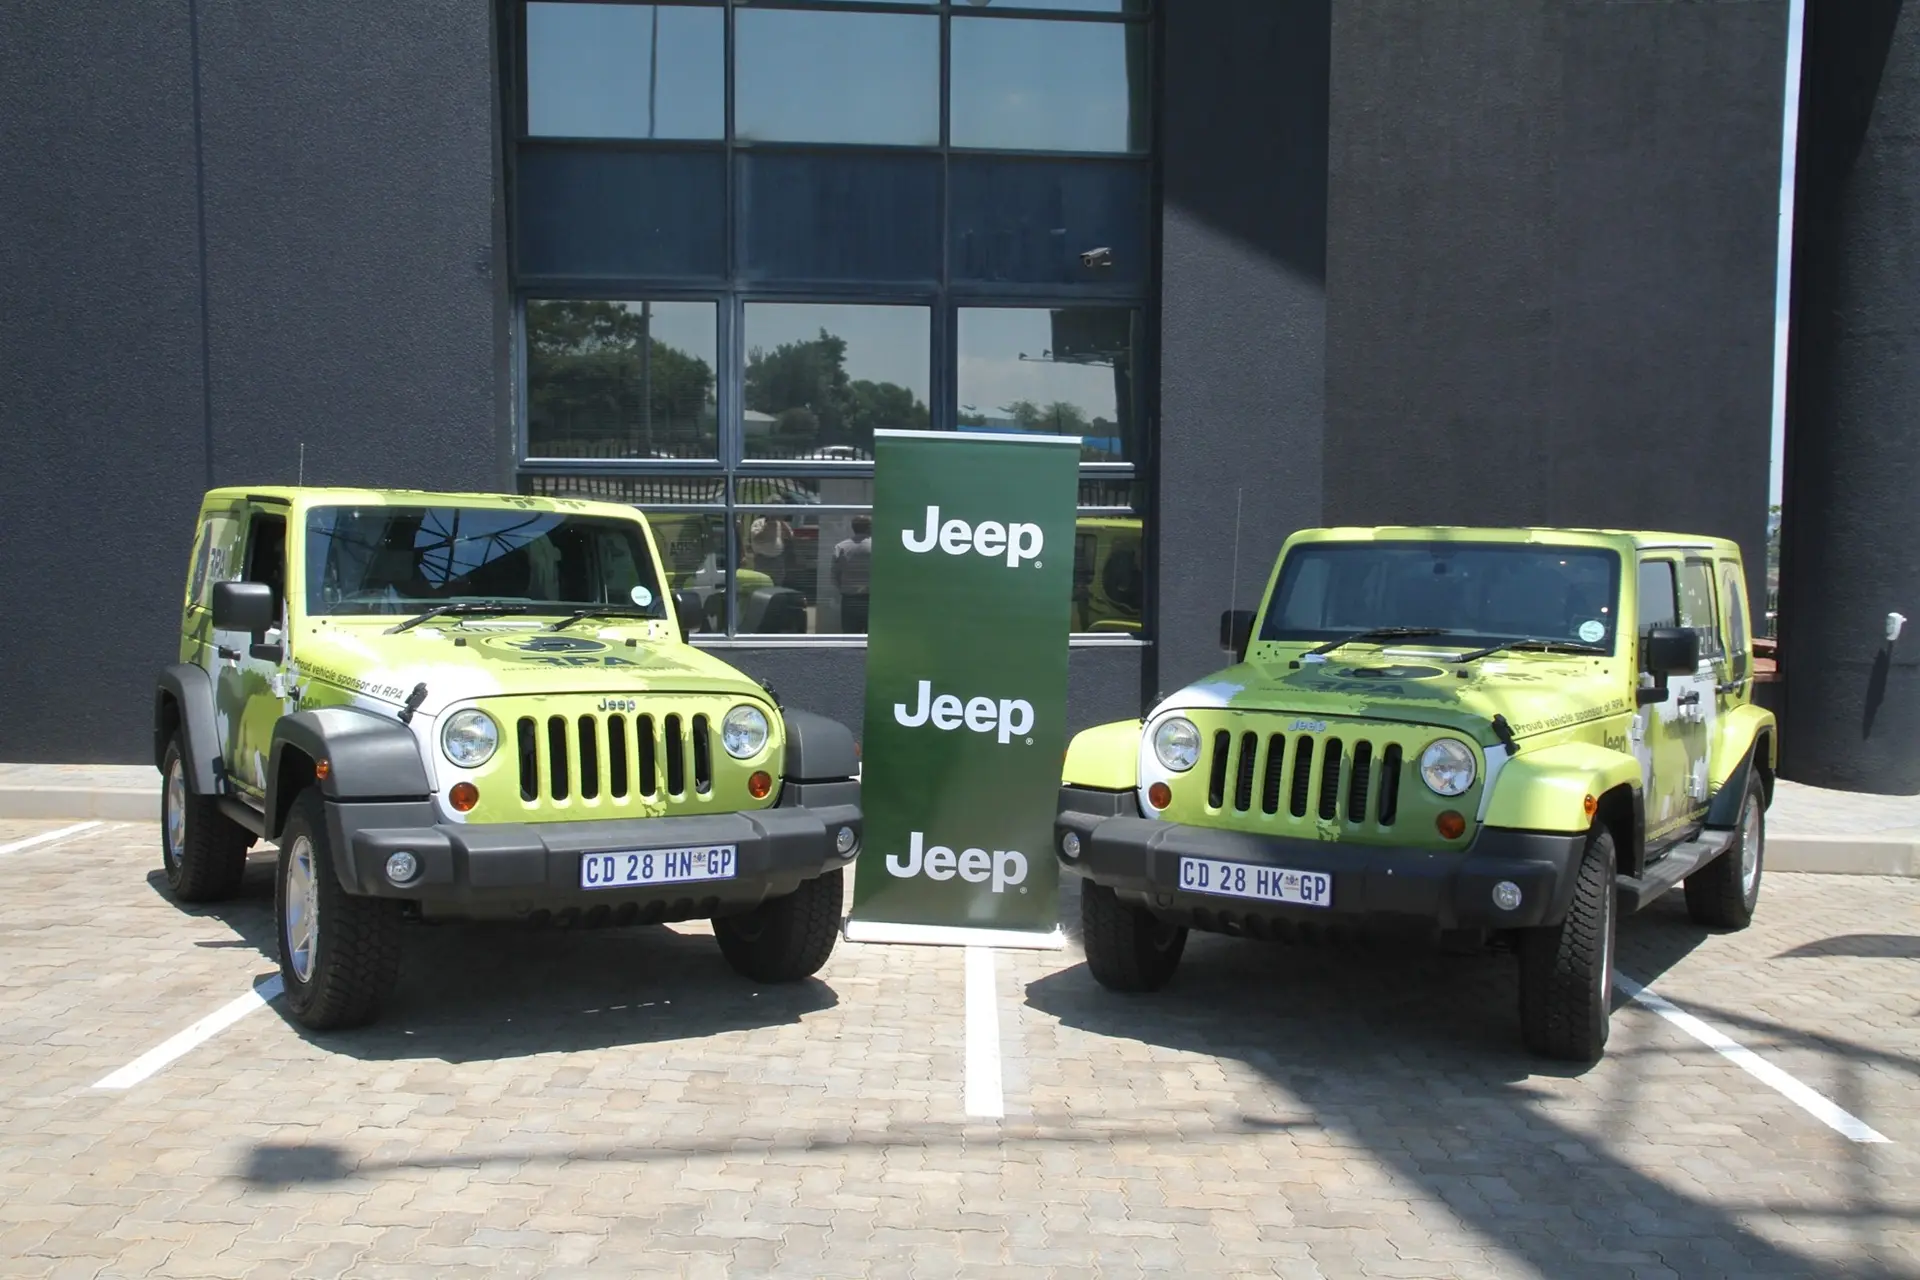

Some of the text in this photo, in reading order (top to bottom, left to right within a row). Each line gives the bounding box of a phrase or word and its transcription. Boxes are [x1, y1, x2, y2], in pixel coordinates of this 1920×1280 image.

[902, 506, 1043, 567] Jeep
[294, 657, 404, 700] Proud vehicle sponsor of RPA
[598, 698, 636, 713] Jeep
[894, 680, 1034, 743] Jeep
[1514, 699, 1624, 734] Proud vehicle sponsor of RPA
[1288, 720, 1326, 733] Jeep
[587, 849, 731, 884] CD 28 HN GP
[886, 832, 1027, 892] Jeep
[1184, 861, 1326, 902] CD 28 HK GP
